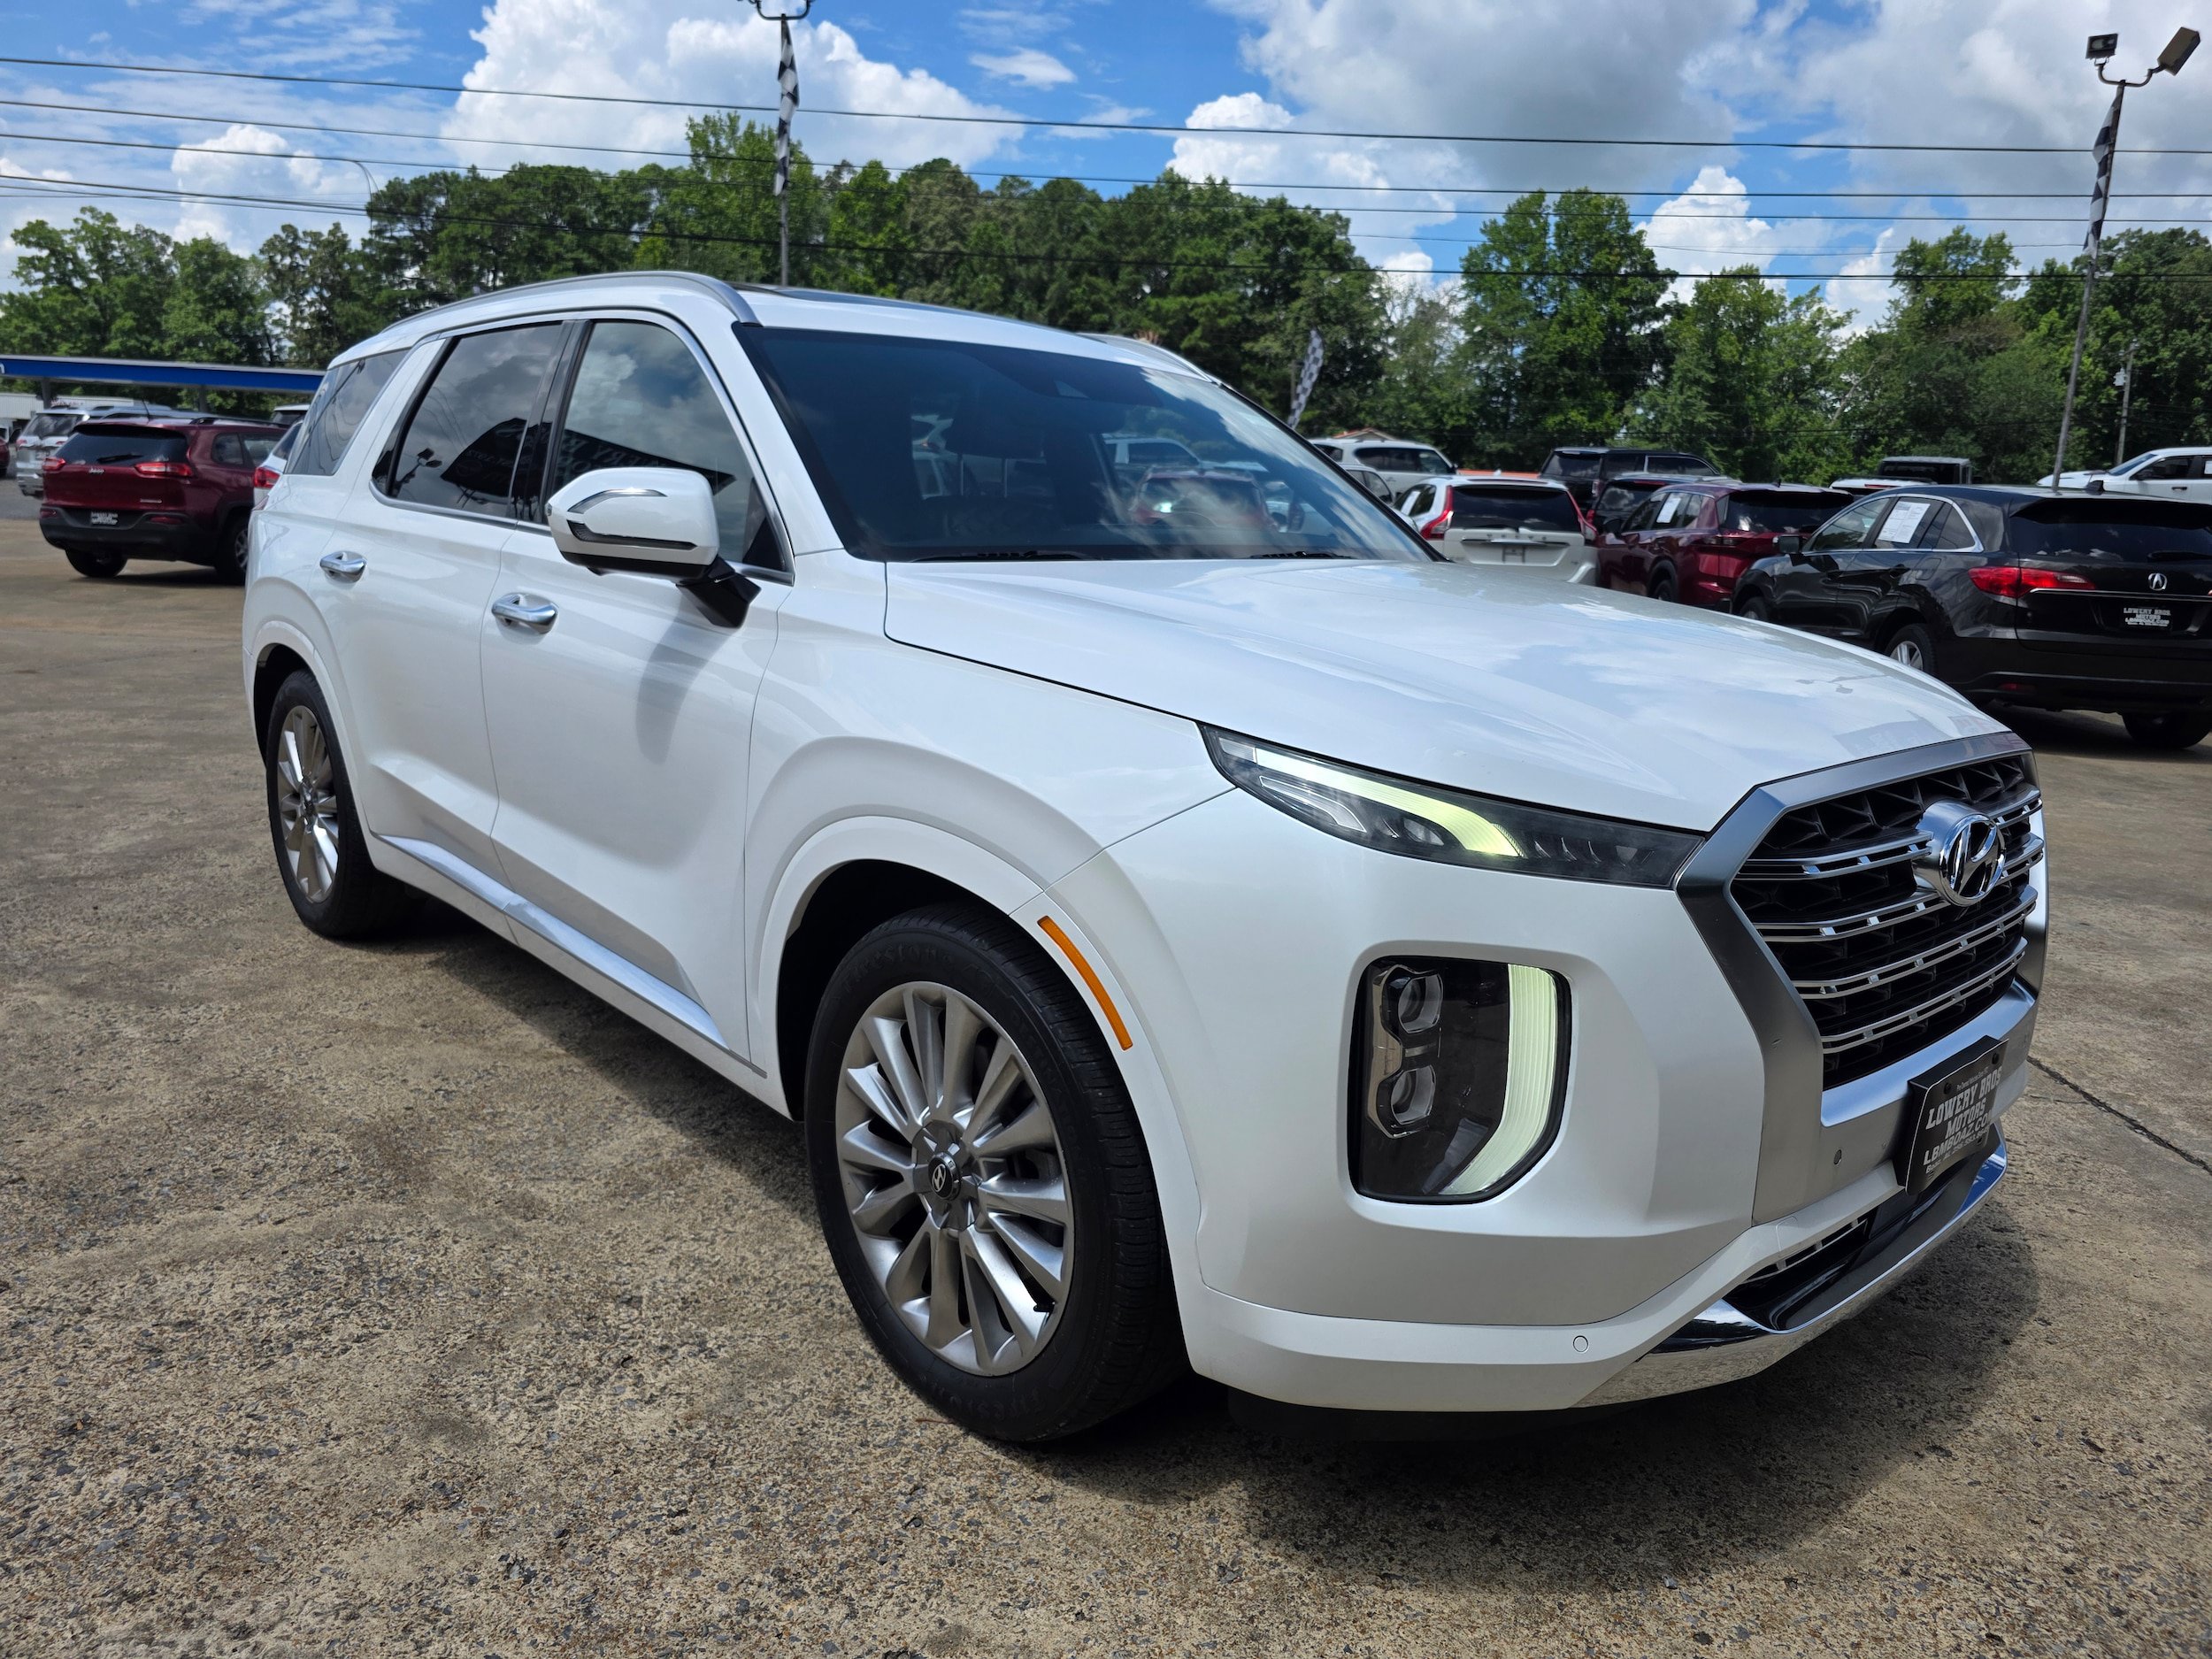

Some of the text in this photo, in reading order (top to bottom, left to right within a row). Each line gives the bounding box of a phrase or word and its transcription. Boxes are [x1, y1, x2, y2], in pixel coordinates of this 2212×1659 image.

[1925, 1082, 1978, 1131] LOWERY
[1978, 1065, 2002, 1100] BROS
[1945, 1097, 1987, 1140] MOTORS
